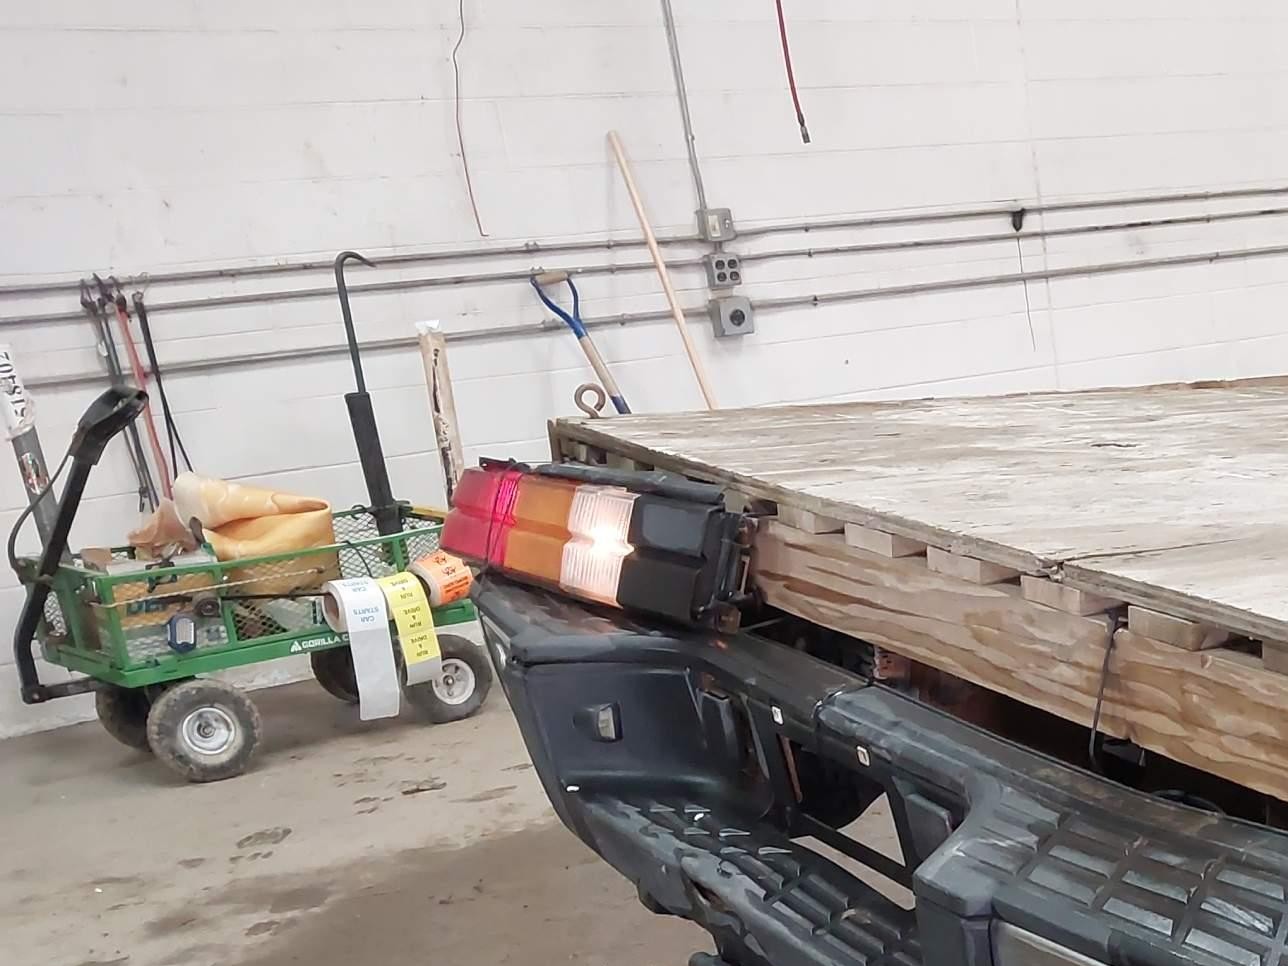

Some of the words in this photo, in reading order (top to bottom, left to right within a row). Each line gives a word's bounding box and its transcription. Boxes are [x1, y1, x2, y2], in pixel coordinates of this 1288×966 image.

[353, 606, 380, 615] STARTS
[403, 606, 421, 615] DRIVE
[301, 635, 341, 649] GORILLA
[410, 635, 428, 643] DRIVE
